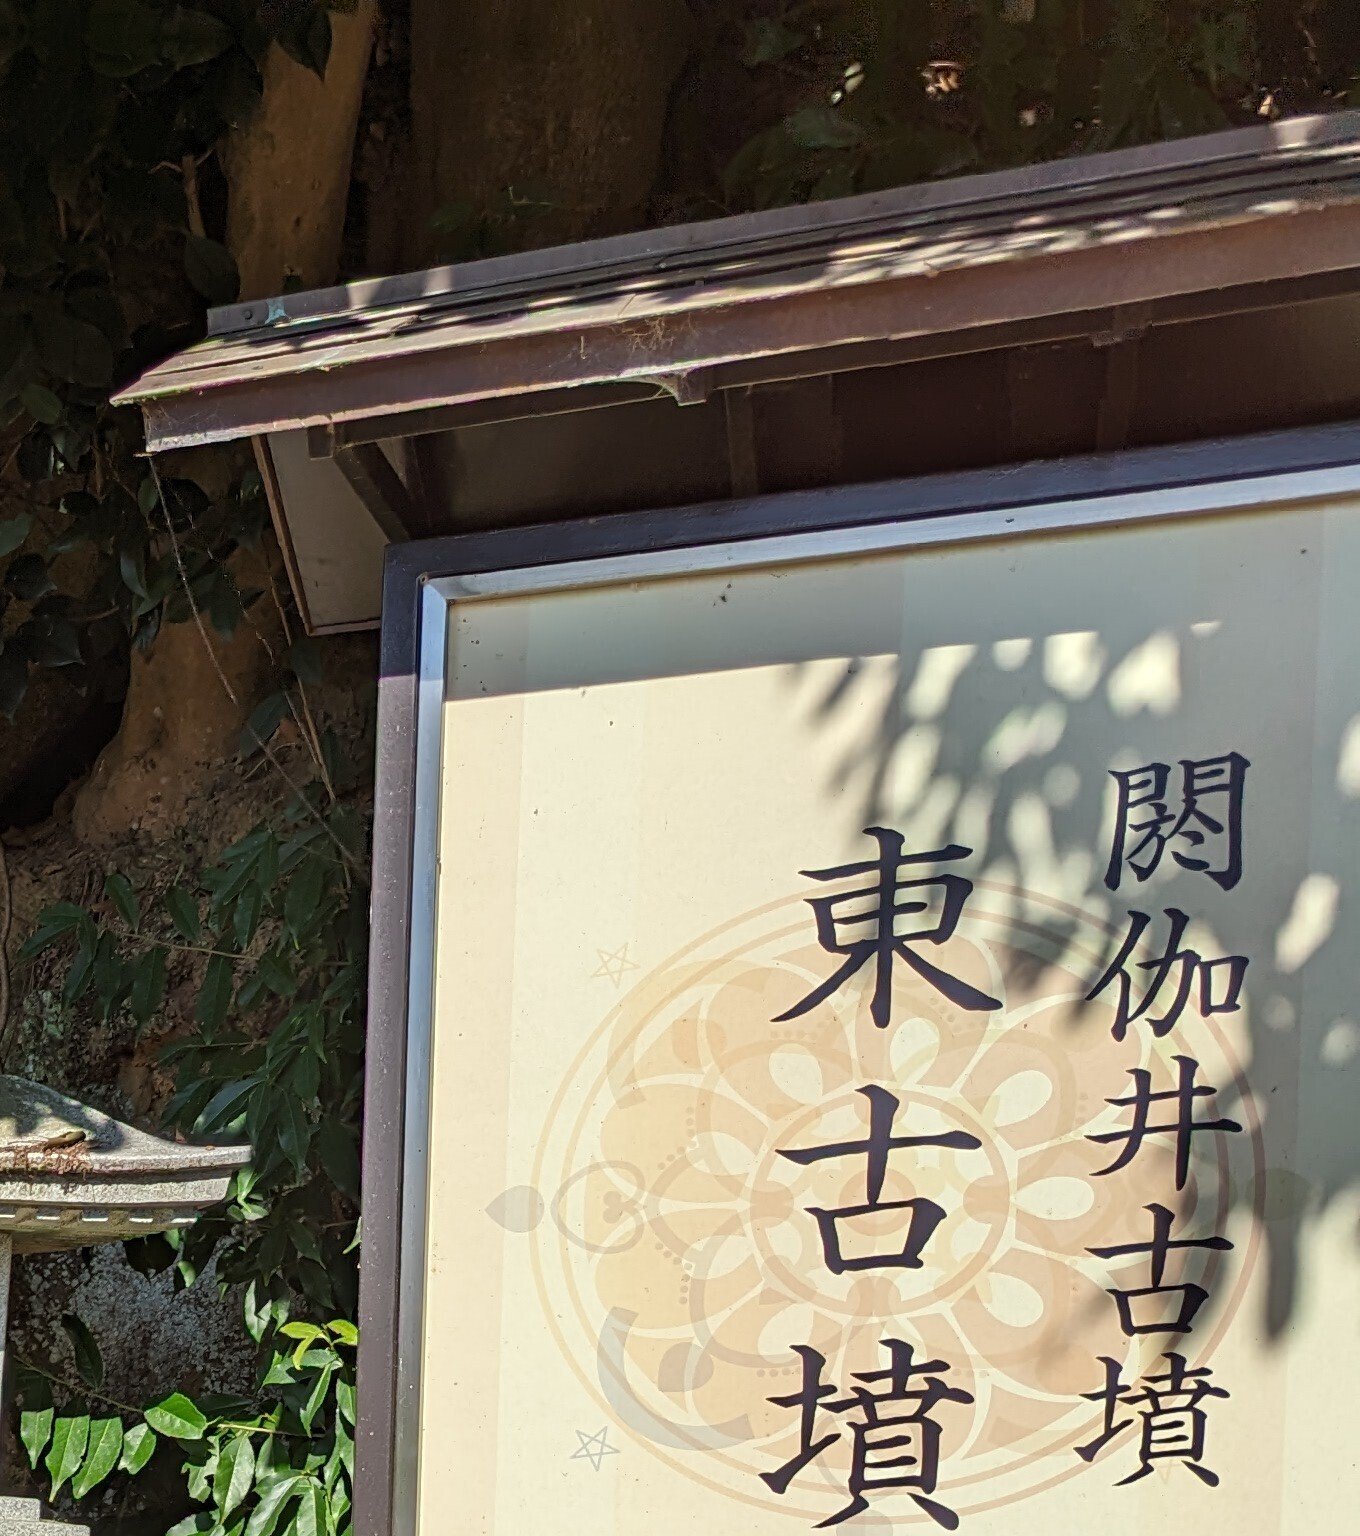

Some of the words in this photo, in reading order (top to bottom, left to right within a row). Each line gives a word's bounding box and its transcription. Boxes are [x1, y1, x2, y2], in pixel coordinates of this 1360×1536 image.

[758, 826, 1005, 1532] 東古墳
[1077, 750, 1253, 1488] 閼伽井古墳
